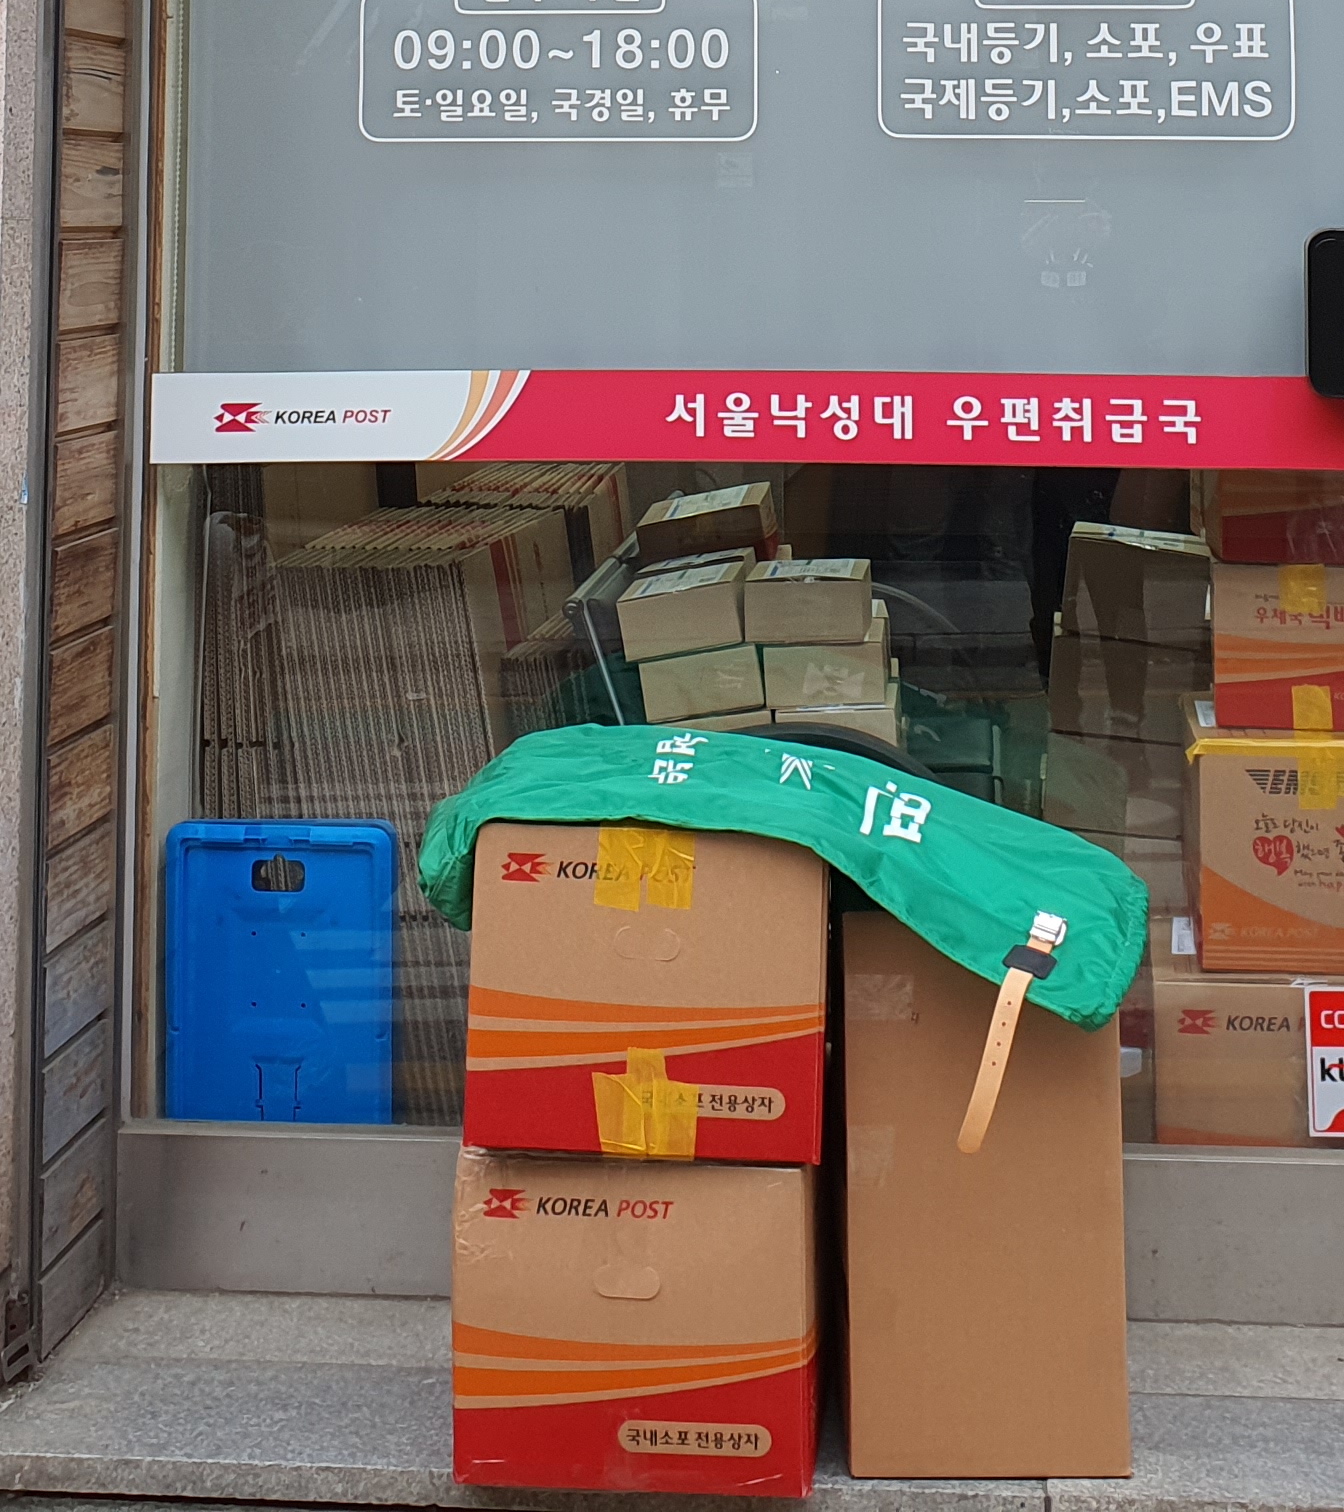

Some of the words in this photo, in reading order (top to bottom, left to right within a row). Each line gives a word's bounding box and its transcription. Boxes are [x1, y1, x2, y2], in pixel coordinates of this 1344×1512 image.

[393, 29, 730, 70] 09:00~18:00
[902, 22, 1073, 67] 국내등기,
[1086, 22, 1178, 67] 소포,
[1190, 22, 1270, 64] 우표
[551, 88, 656, 123] 국경일,
[668, 88, 731, 121] 휴무
[274, 410, 337, 425] KOREA
[341, 408, 392, 425] POST
[665, 393, 914, 441] 서울낙성대
[946, 395, 1203, 446] 우편취급국
[1226, 1015, 1291, 1032] KOREA
[709, 1094, 775, 1114] 전용상자
[536, 1196, 609, 1218] KOREA
[617, 1200, 674, 1219] POST
[626, 1428, 690, 1446] 국내소포
[695, 1431, 759, 1450] 전용상자
